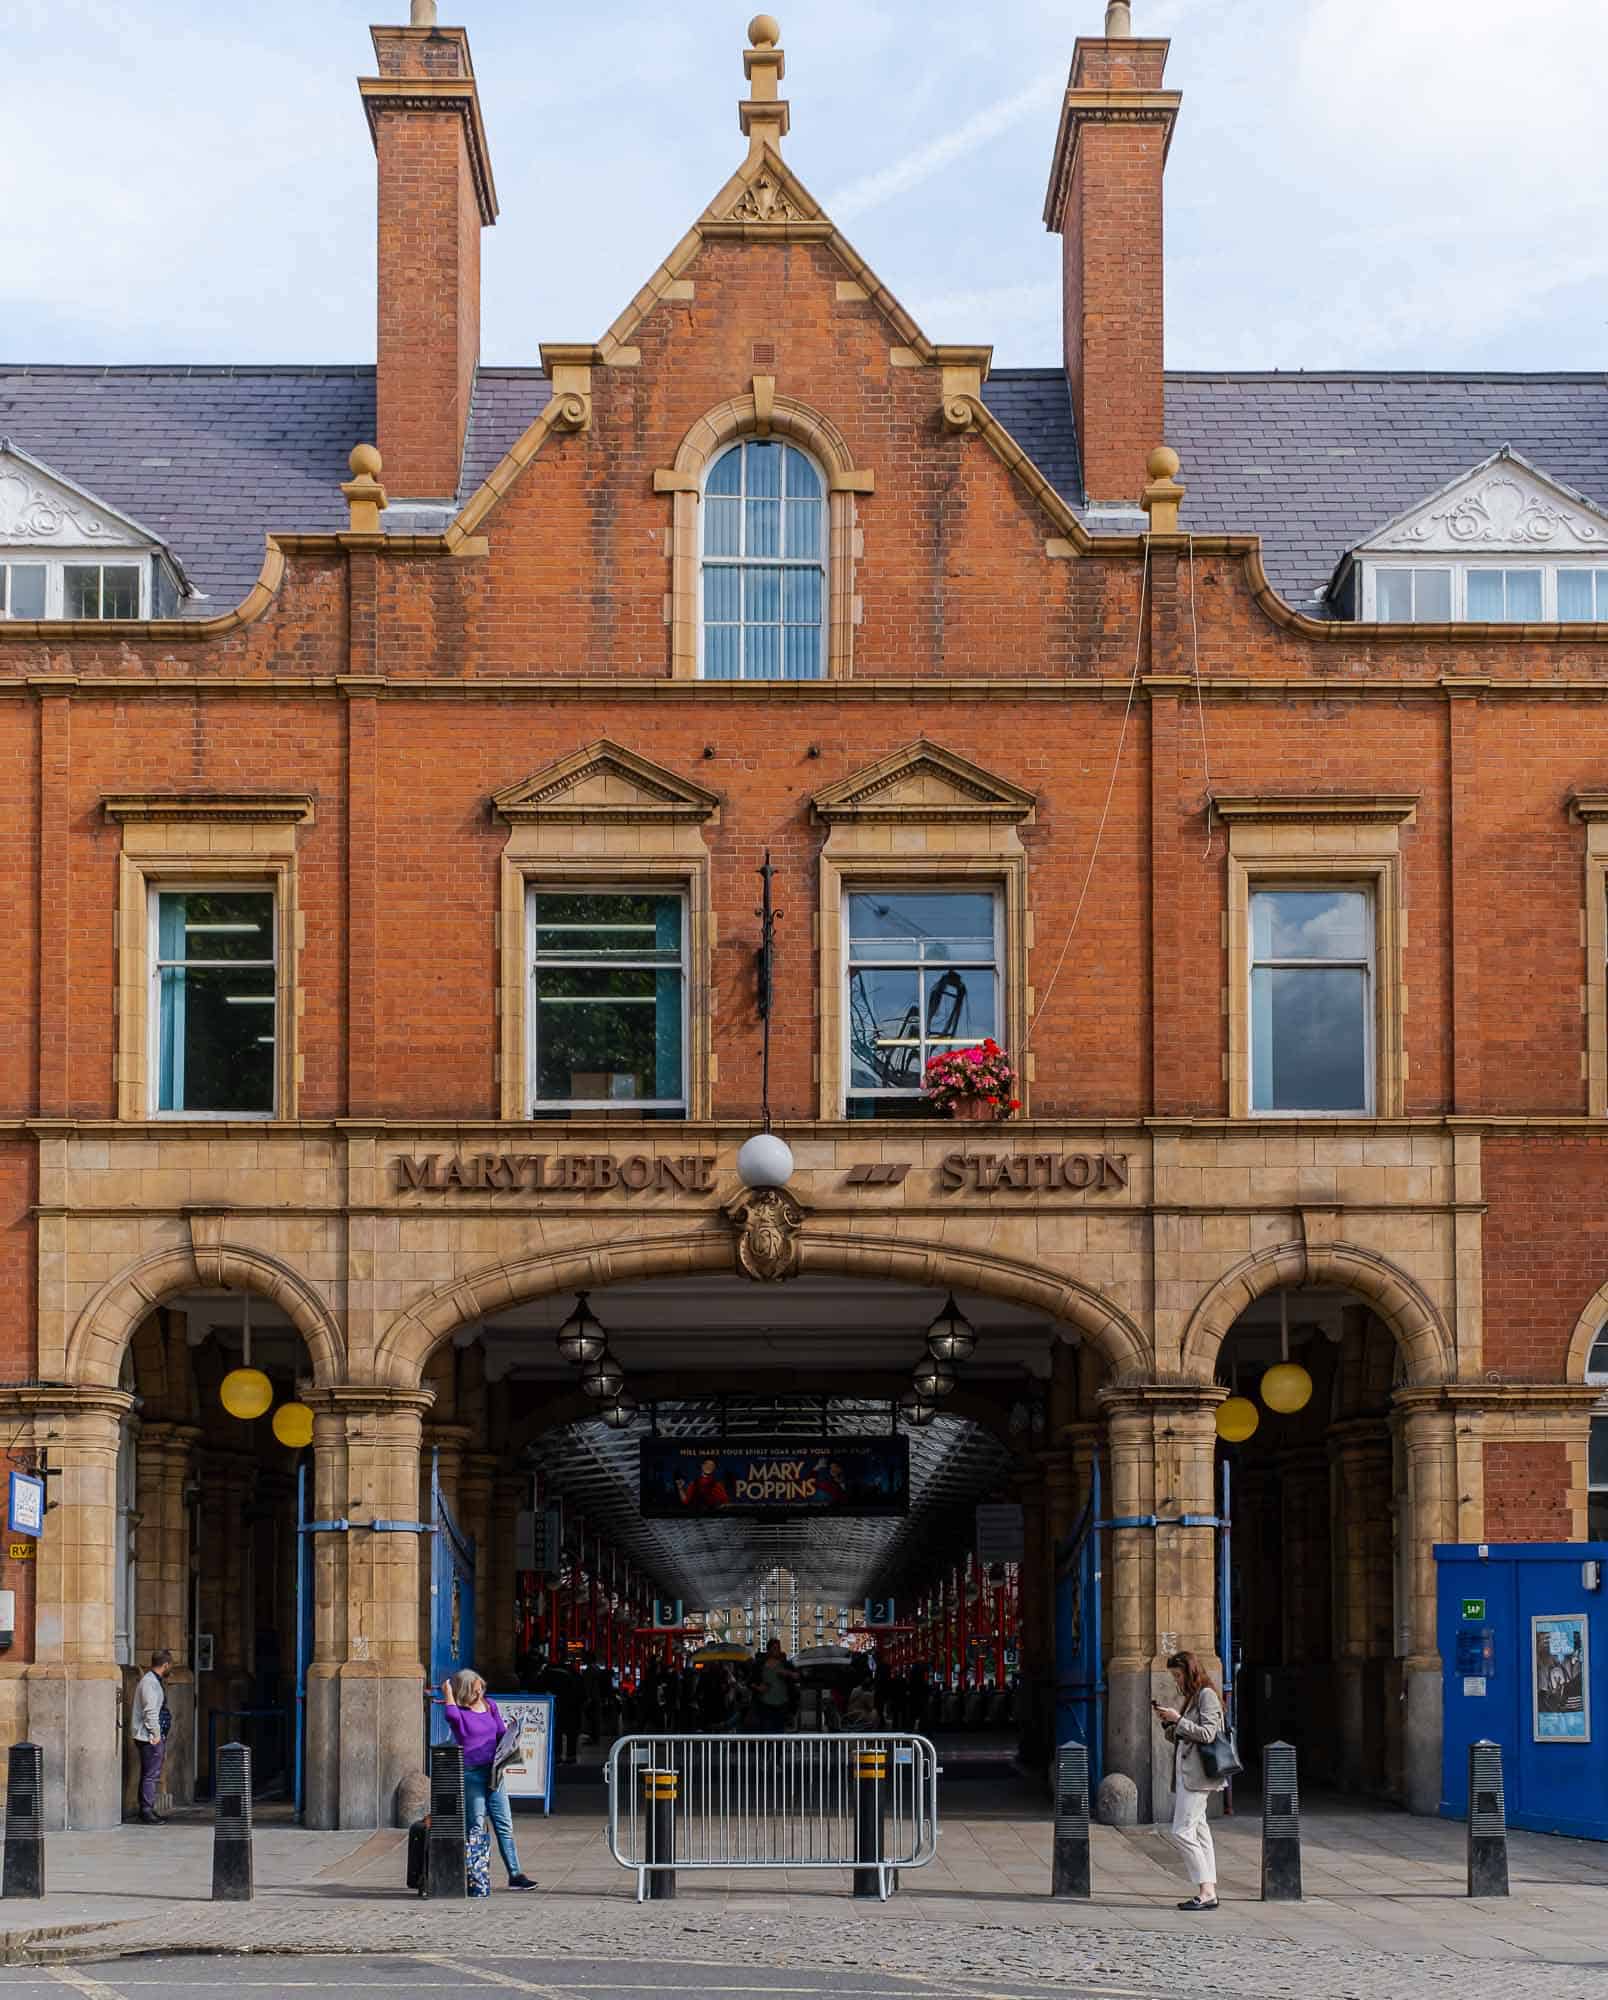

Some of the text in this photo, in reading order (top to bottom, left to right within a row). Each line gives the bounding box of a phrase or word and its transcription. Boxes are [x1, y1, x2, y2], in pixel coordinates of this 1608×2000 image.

[397, 1152, 1130, 1190] MARYLEBONE STATION
[748, 1461, 805, 1481] MARY
[735, 1478, 817, 1500] POPPINS
[663, 1605, 673, 1621] 3
[874, 1602, 886, 1619] 2
